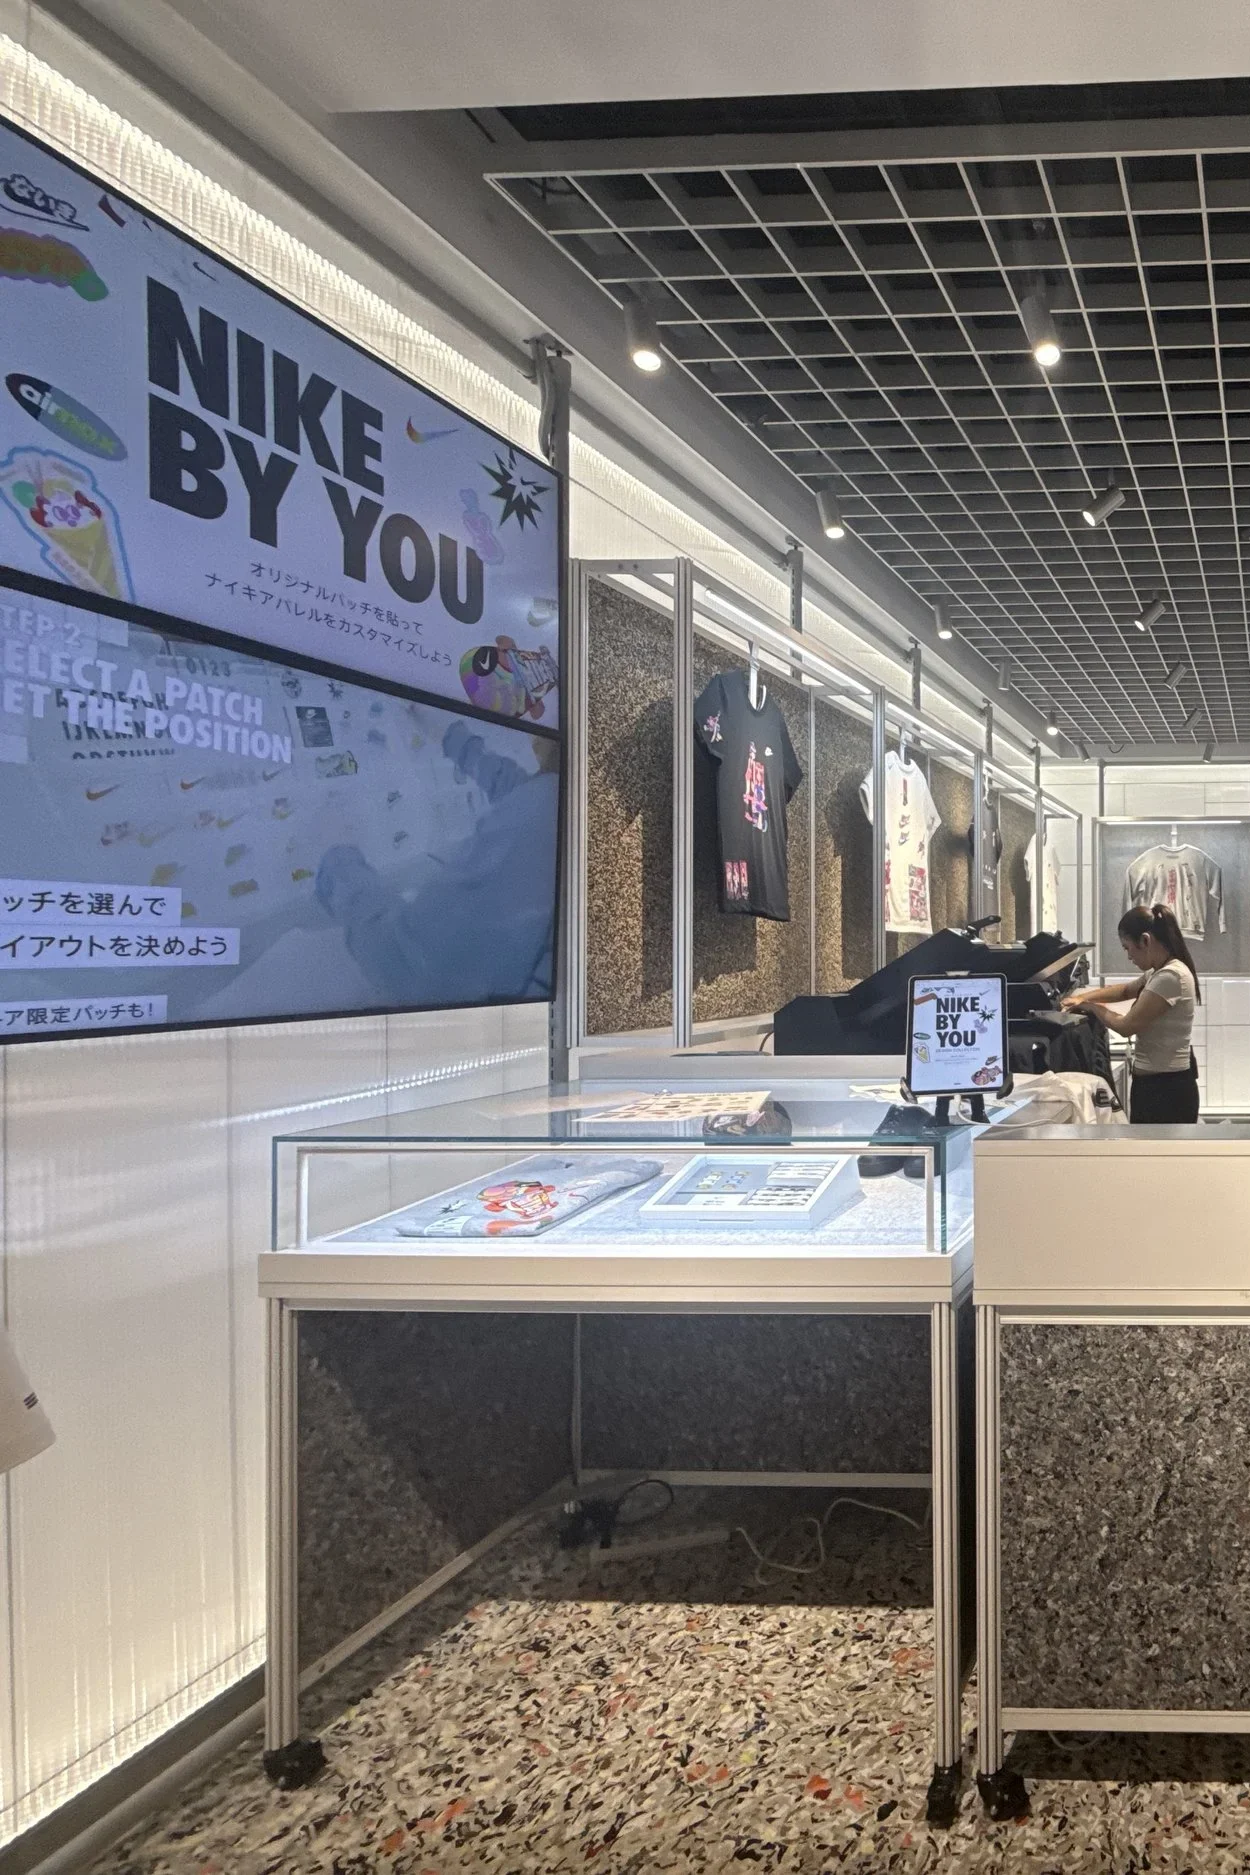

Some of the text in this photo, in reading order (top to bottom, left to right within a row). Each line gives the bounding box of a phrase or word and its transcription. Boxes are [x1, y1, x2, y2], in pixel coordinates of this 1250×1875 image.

[147, 277, 385, 497] NIKE
[148, 393, 485, 625] BY YOU
[63, 623, 82, 645] 2
[204, 573, 453, 667] ナイキアパレルをカスタマイズしよう
[250, 562, 424, 636] オリジナルパッチを貼って
[4, 640, 118, 693] ELECT
[127, 669, 151, 701] A
[165, 677, 263, 726] PATCH
[62, 691, 134, 734] THE
[145, 709, 292, 764] POSITION
[0, 1003, 153, 1027] ア限定パッチも!
[936, 997, 980, 1013] NIKE
[936, 1014, 961, 1030] BY
[936, 1030, 976, 1047] YOU
